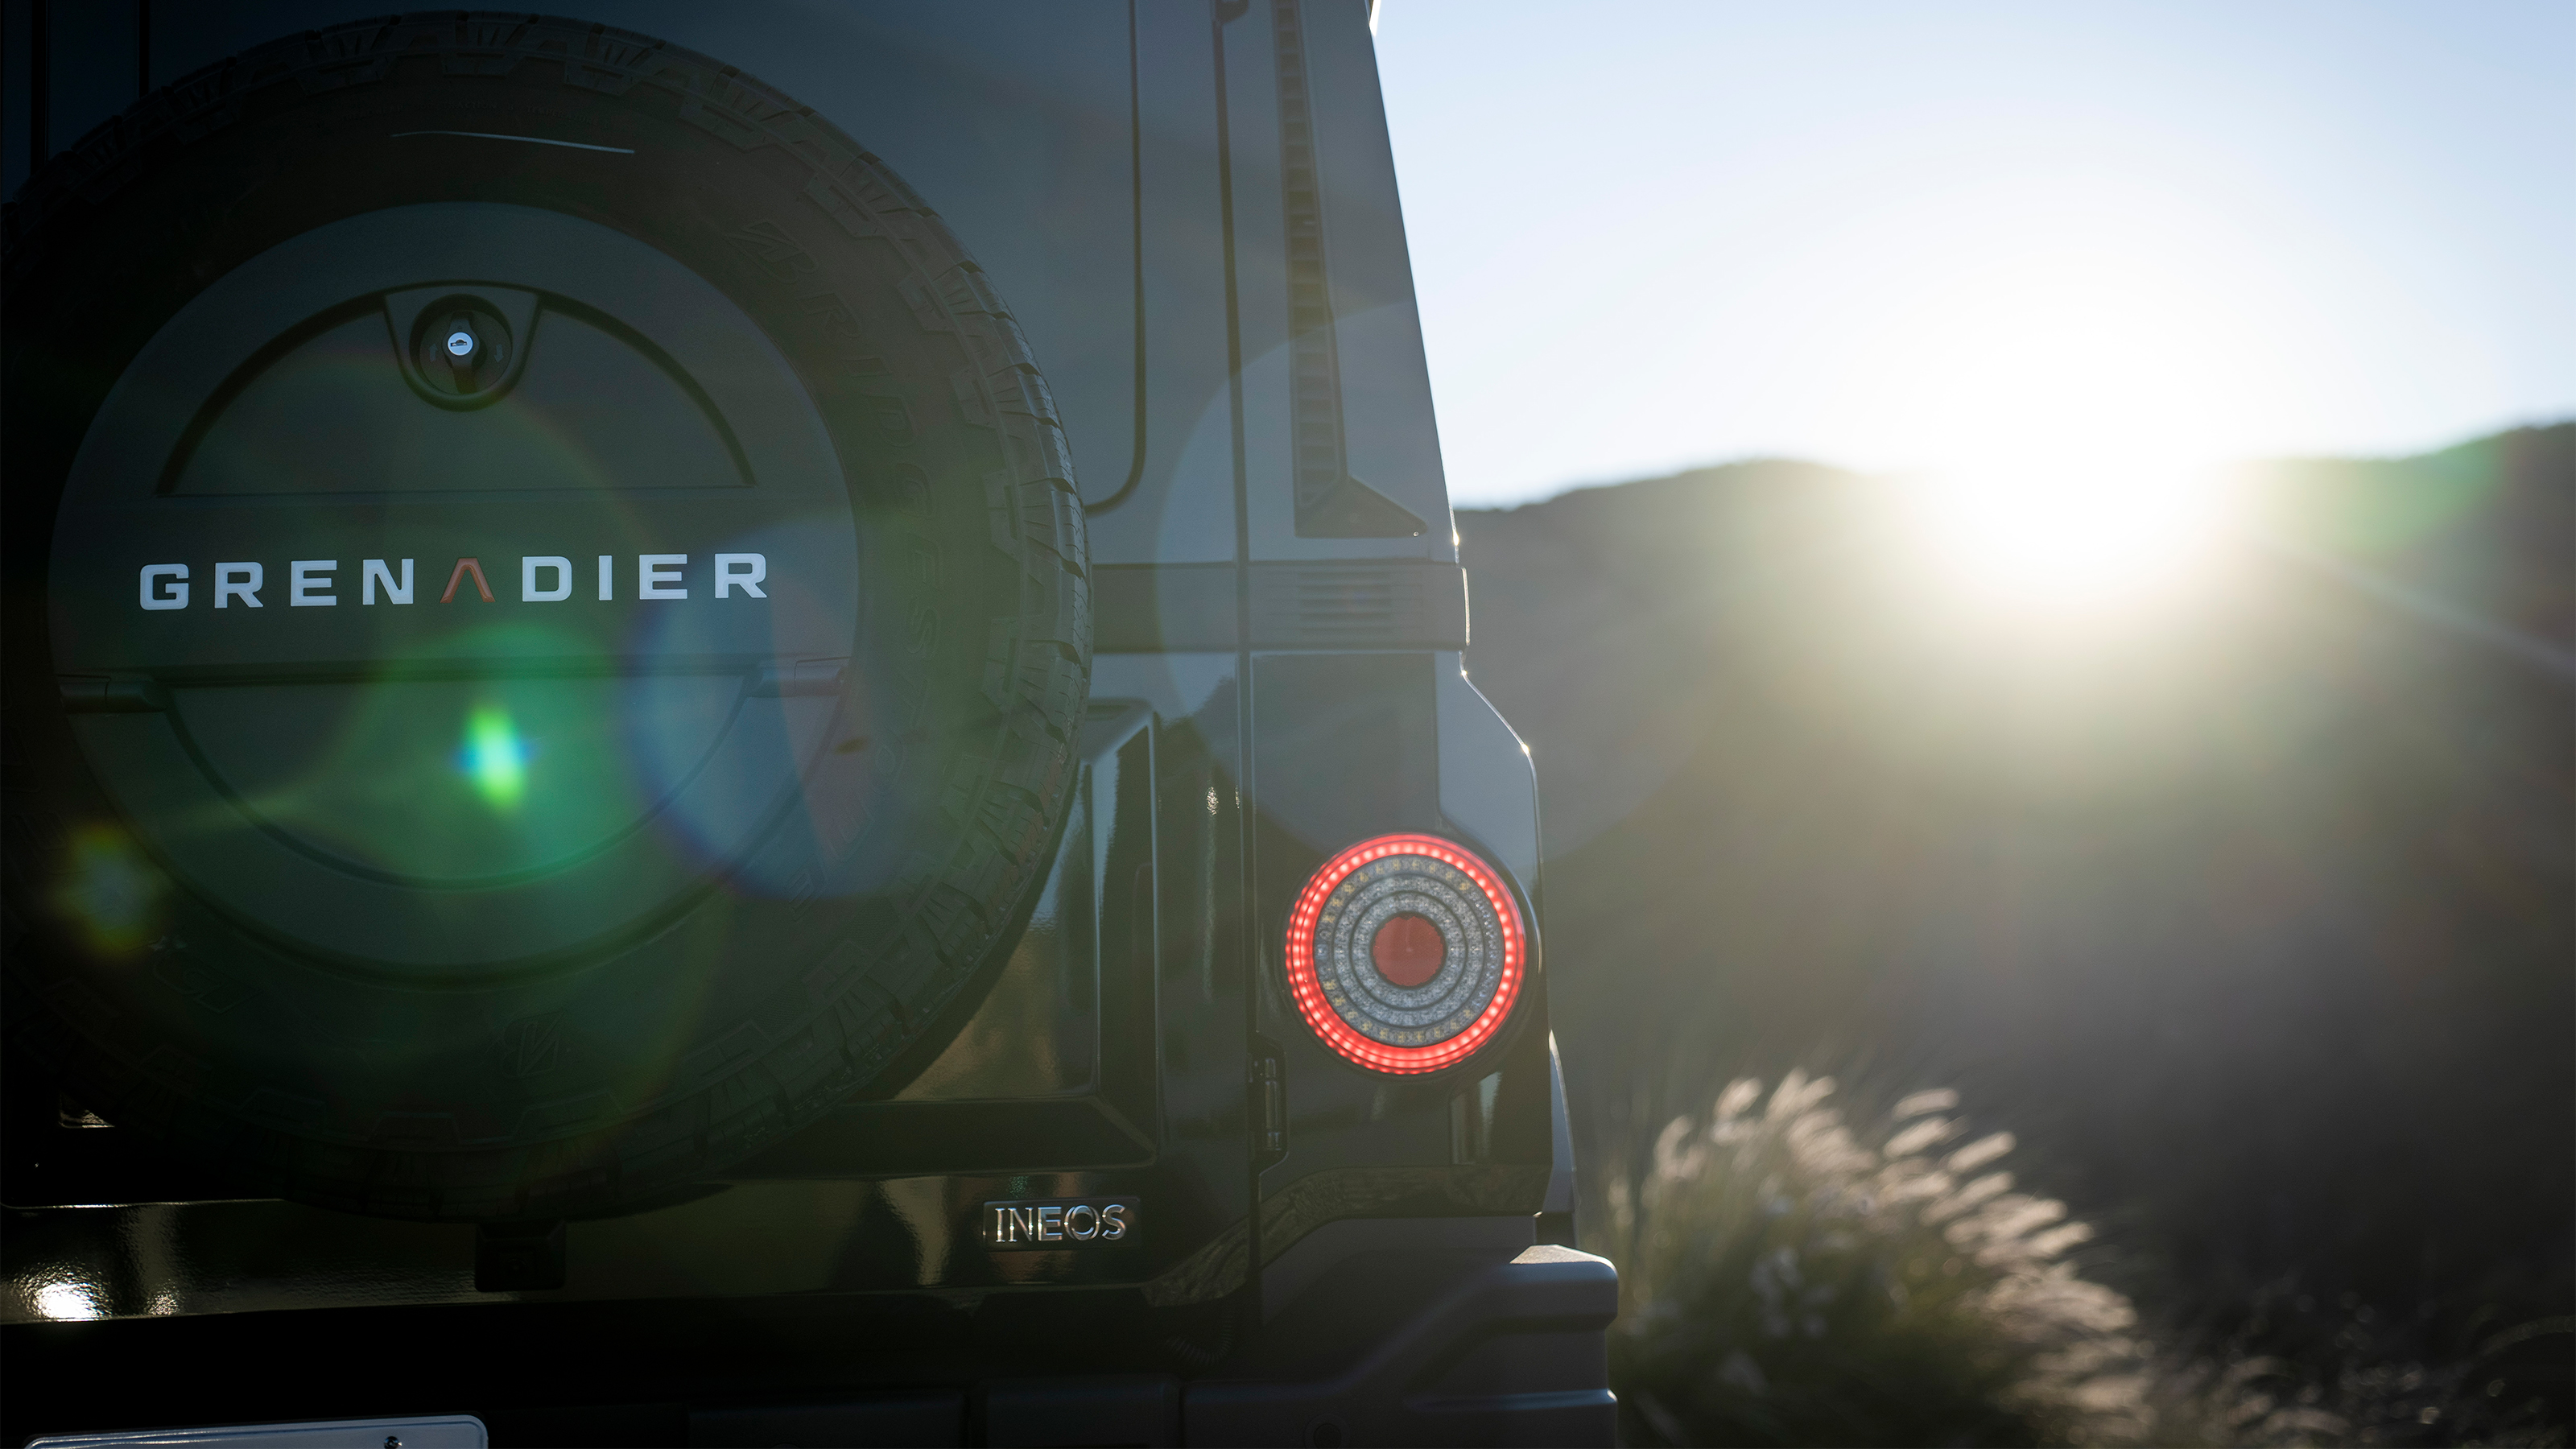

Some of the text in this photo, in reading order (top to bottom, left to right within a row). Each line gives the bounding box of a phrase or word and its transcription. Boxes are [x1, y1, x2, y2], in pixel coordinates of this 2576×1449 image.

[139, 552, 768, 611] GRENADIER
[724, 219, 945, 923] BRIDGESTONE
[995, 1204, 1126, 1243] INEOS
